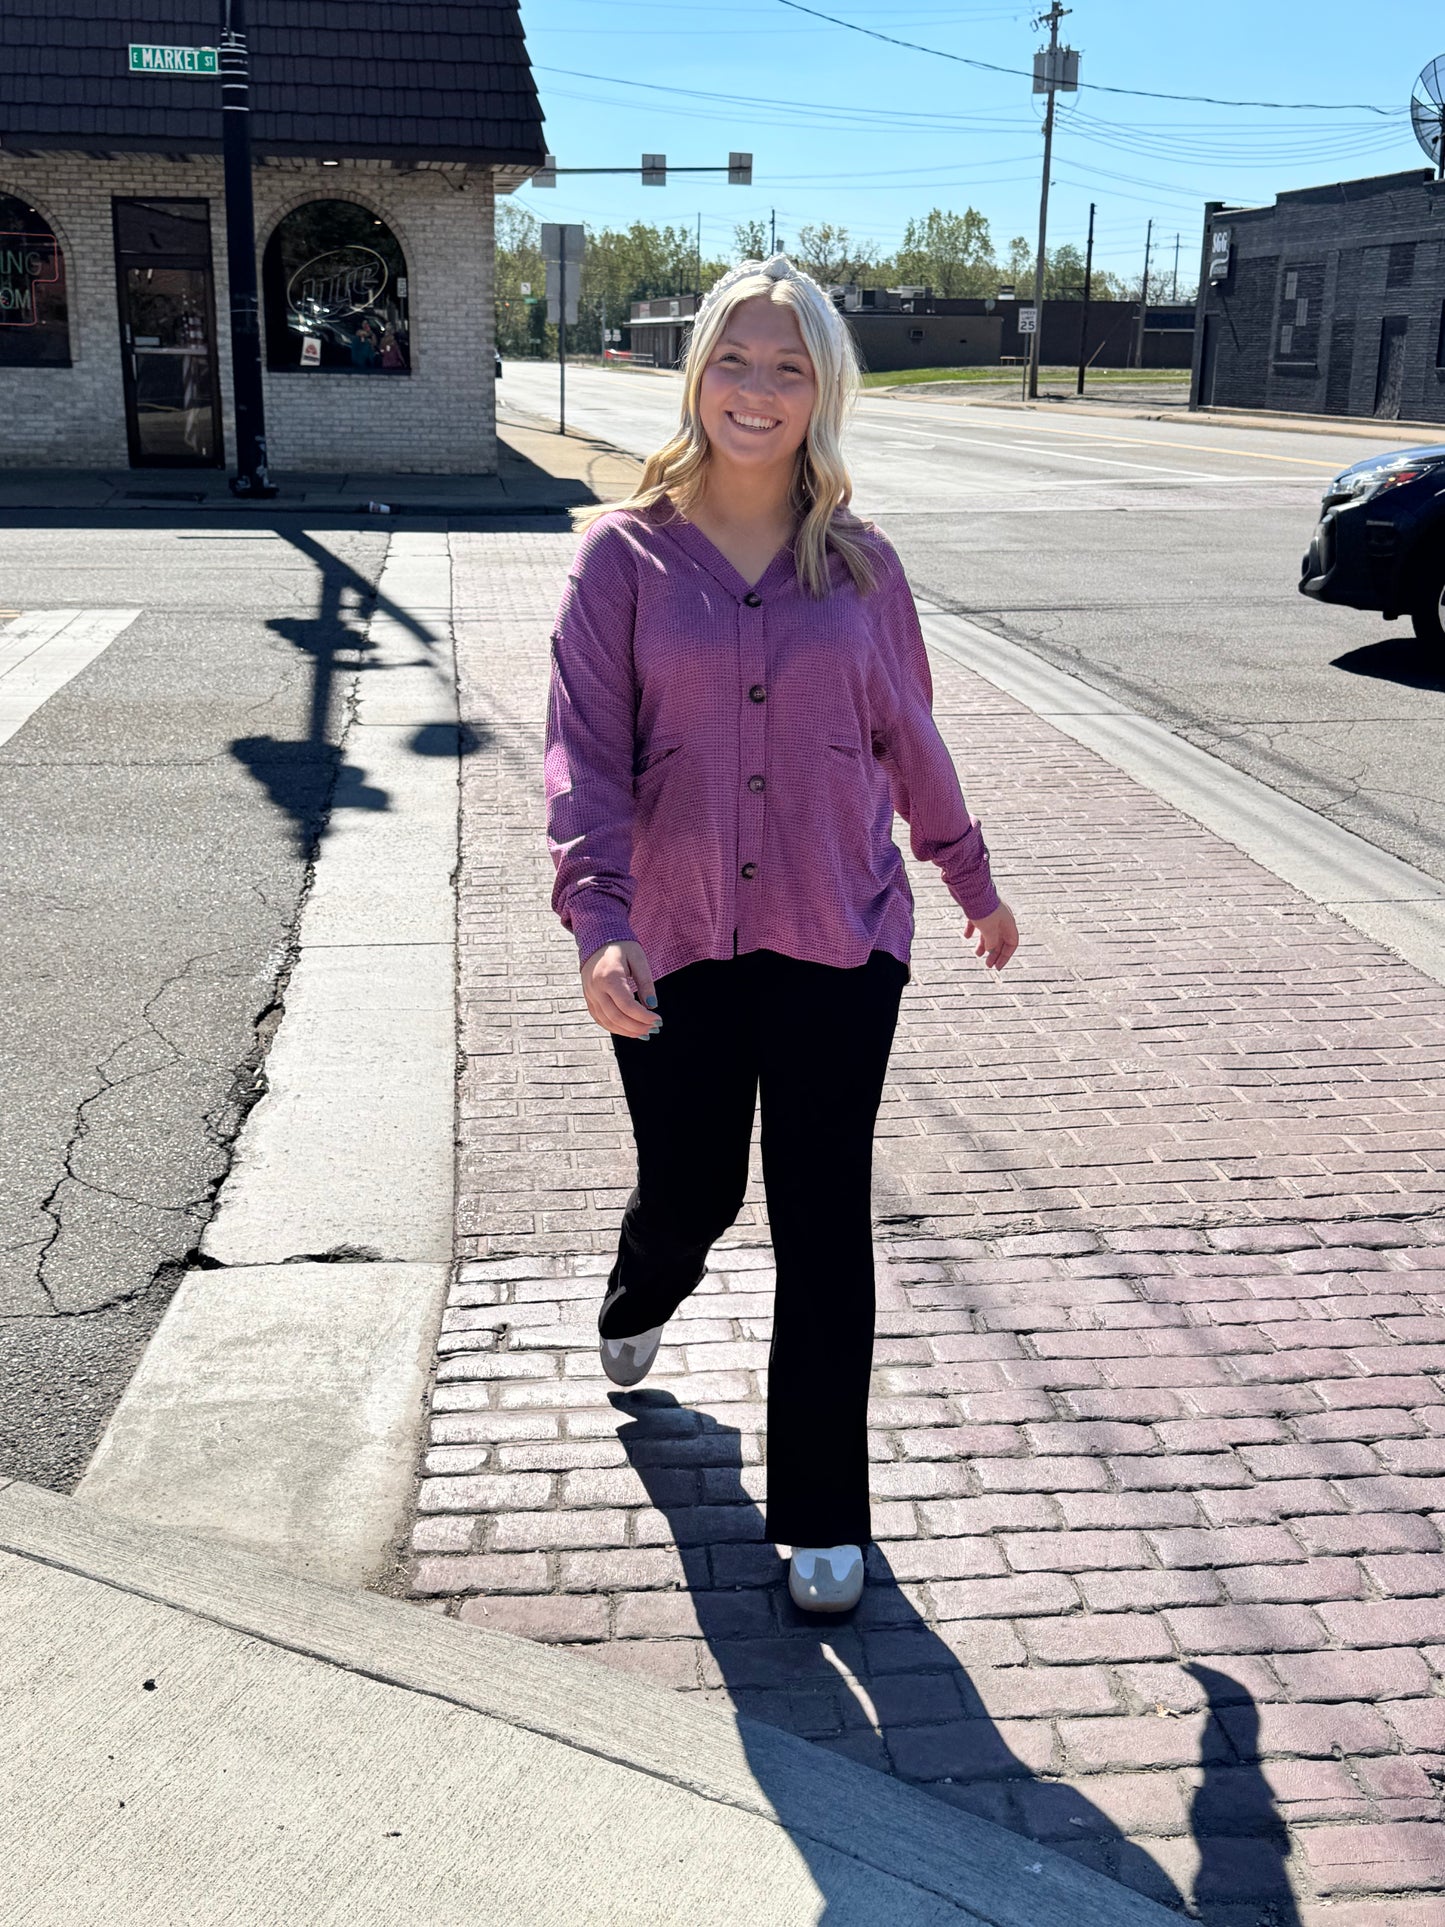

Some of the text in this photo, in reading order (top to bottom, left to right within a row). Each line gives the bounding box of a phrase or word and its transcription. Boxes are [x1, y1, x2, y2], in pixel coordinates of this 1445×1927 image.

[133, 48, 213, 70] E MARKET ST
[1020, 321, 1035, 331] 25
